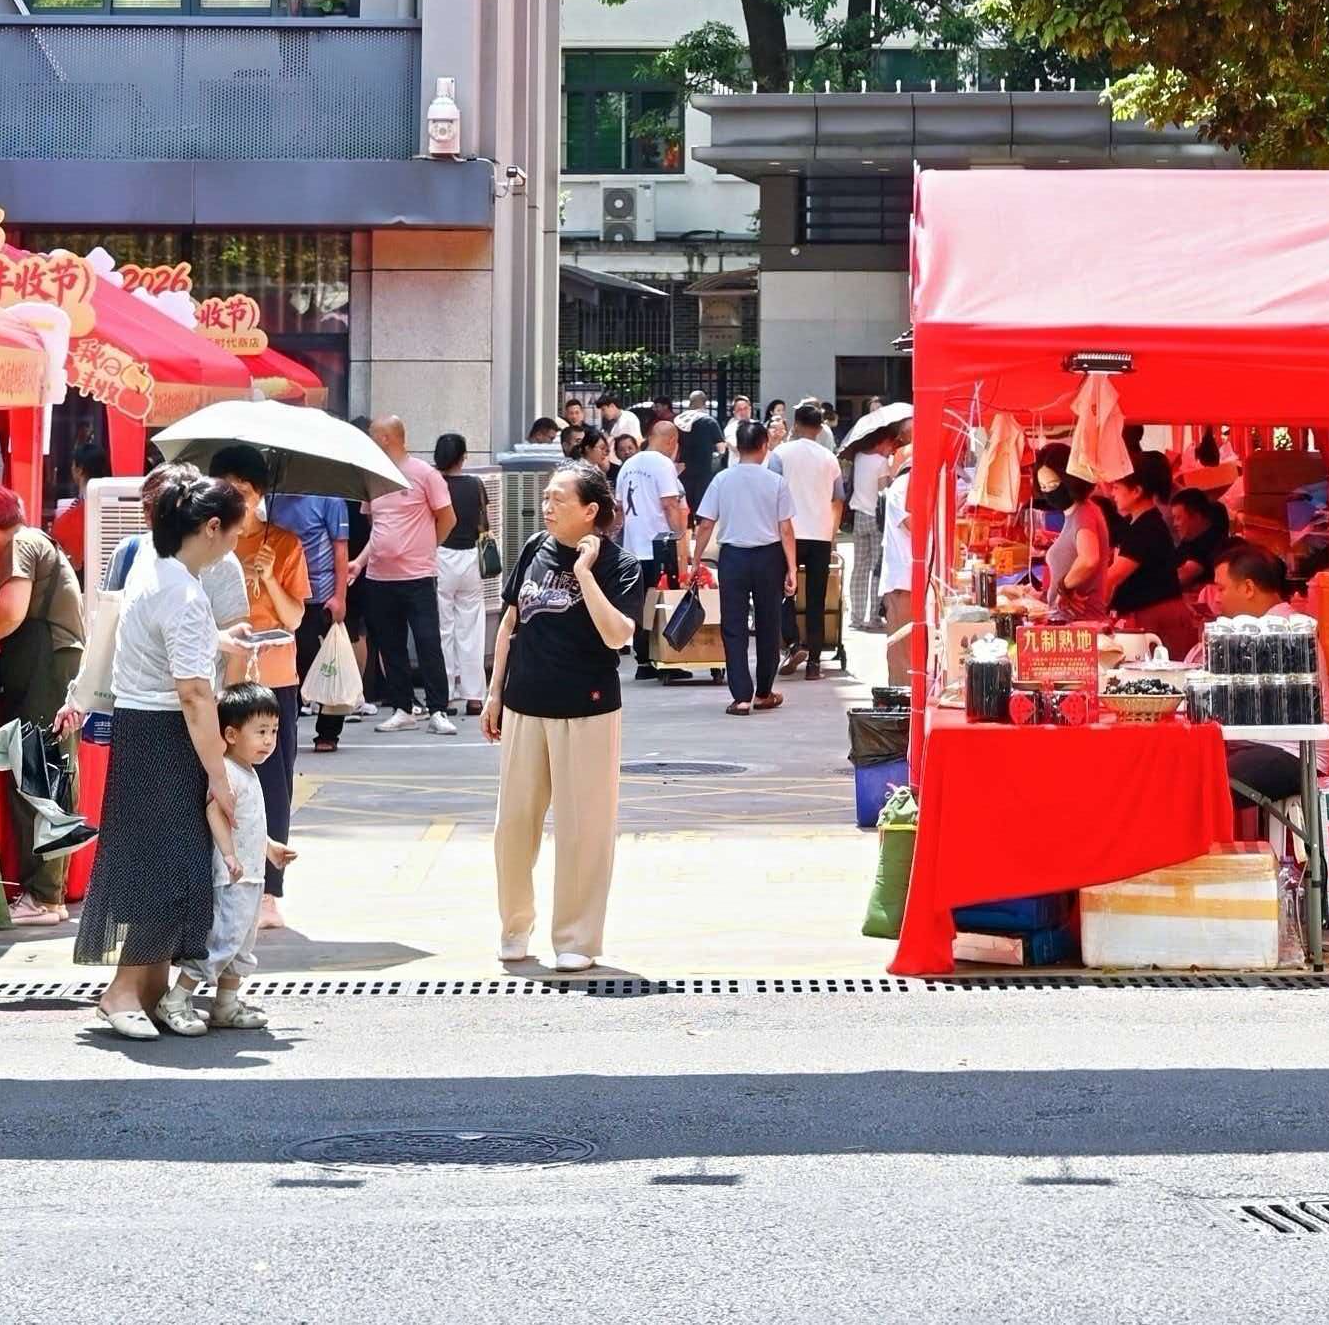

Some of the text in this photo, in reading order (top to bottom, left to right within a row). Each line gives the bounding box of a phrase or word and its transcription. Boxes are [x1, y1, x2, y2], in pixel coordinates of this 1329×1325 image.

[195, 297, 255, 333] 收节)
[1023, 629, 1092, 653] 九制熟地
